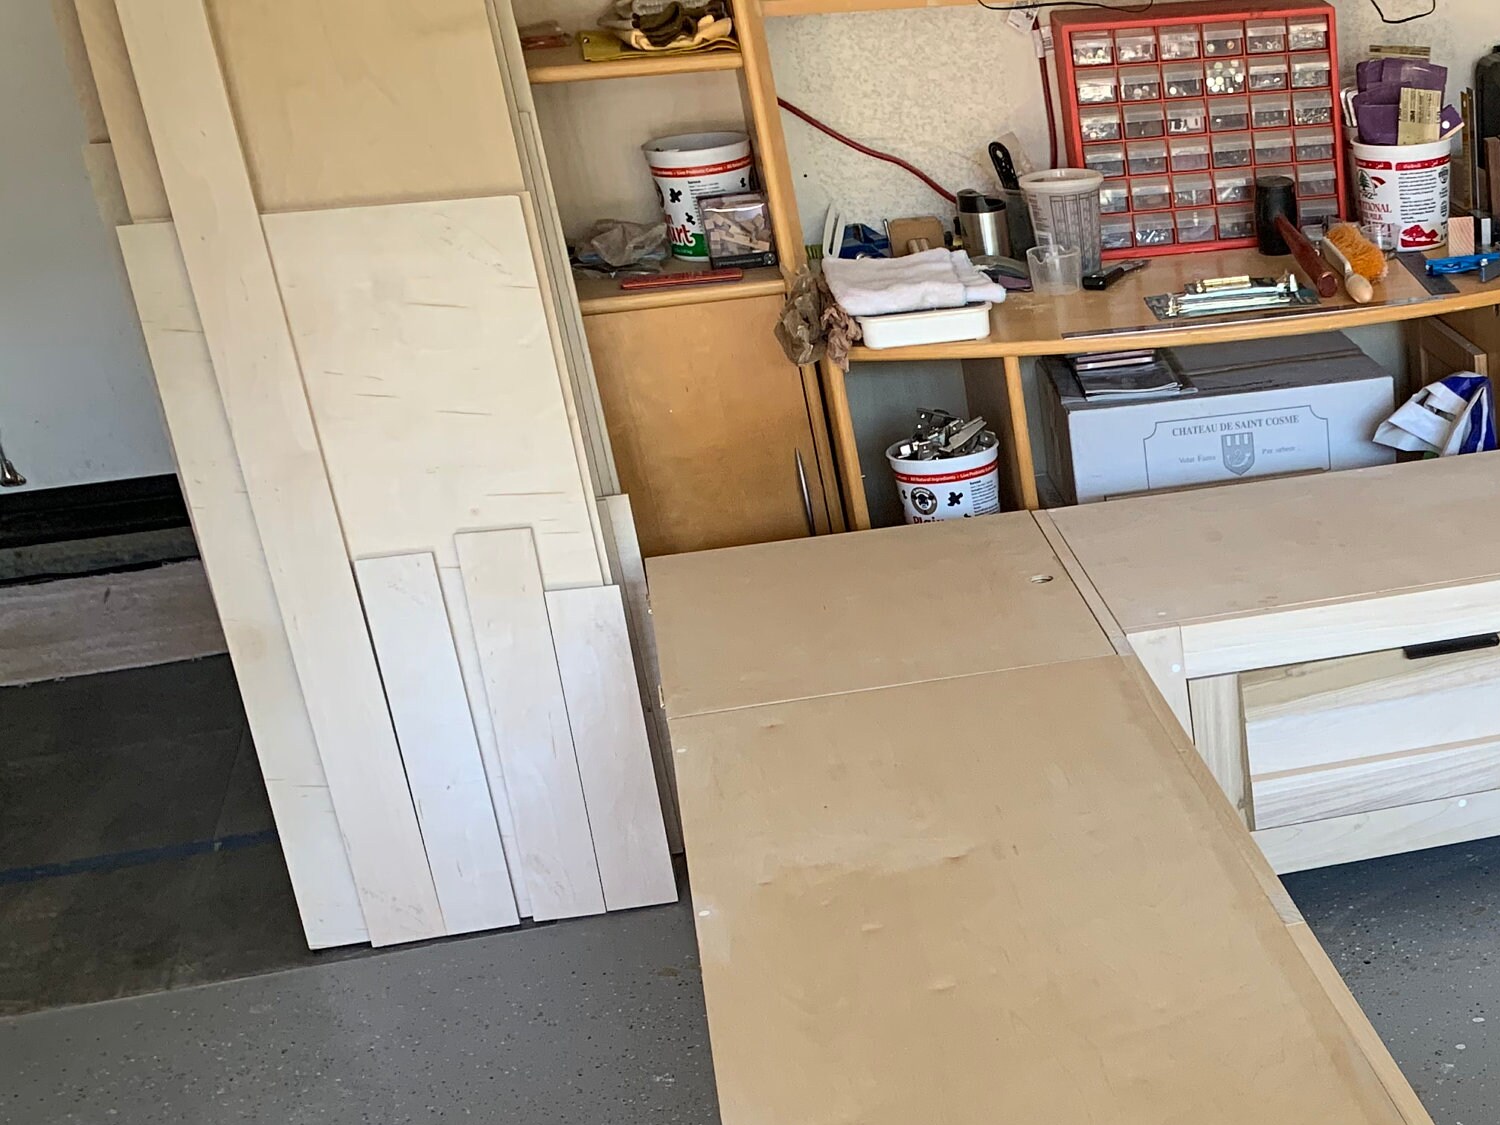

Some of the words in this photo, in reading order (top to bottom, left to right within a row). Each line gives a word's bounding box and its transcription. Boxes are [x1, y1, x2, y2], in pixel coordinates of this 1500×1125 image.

[1172, 423, 1218, 437] CHATEAU
[1219, 421, 1233, 432] DE
[1234, 418, 1263, 431] SAINT
[1265, 415, 1300, 427] COSME
